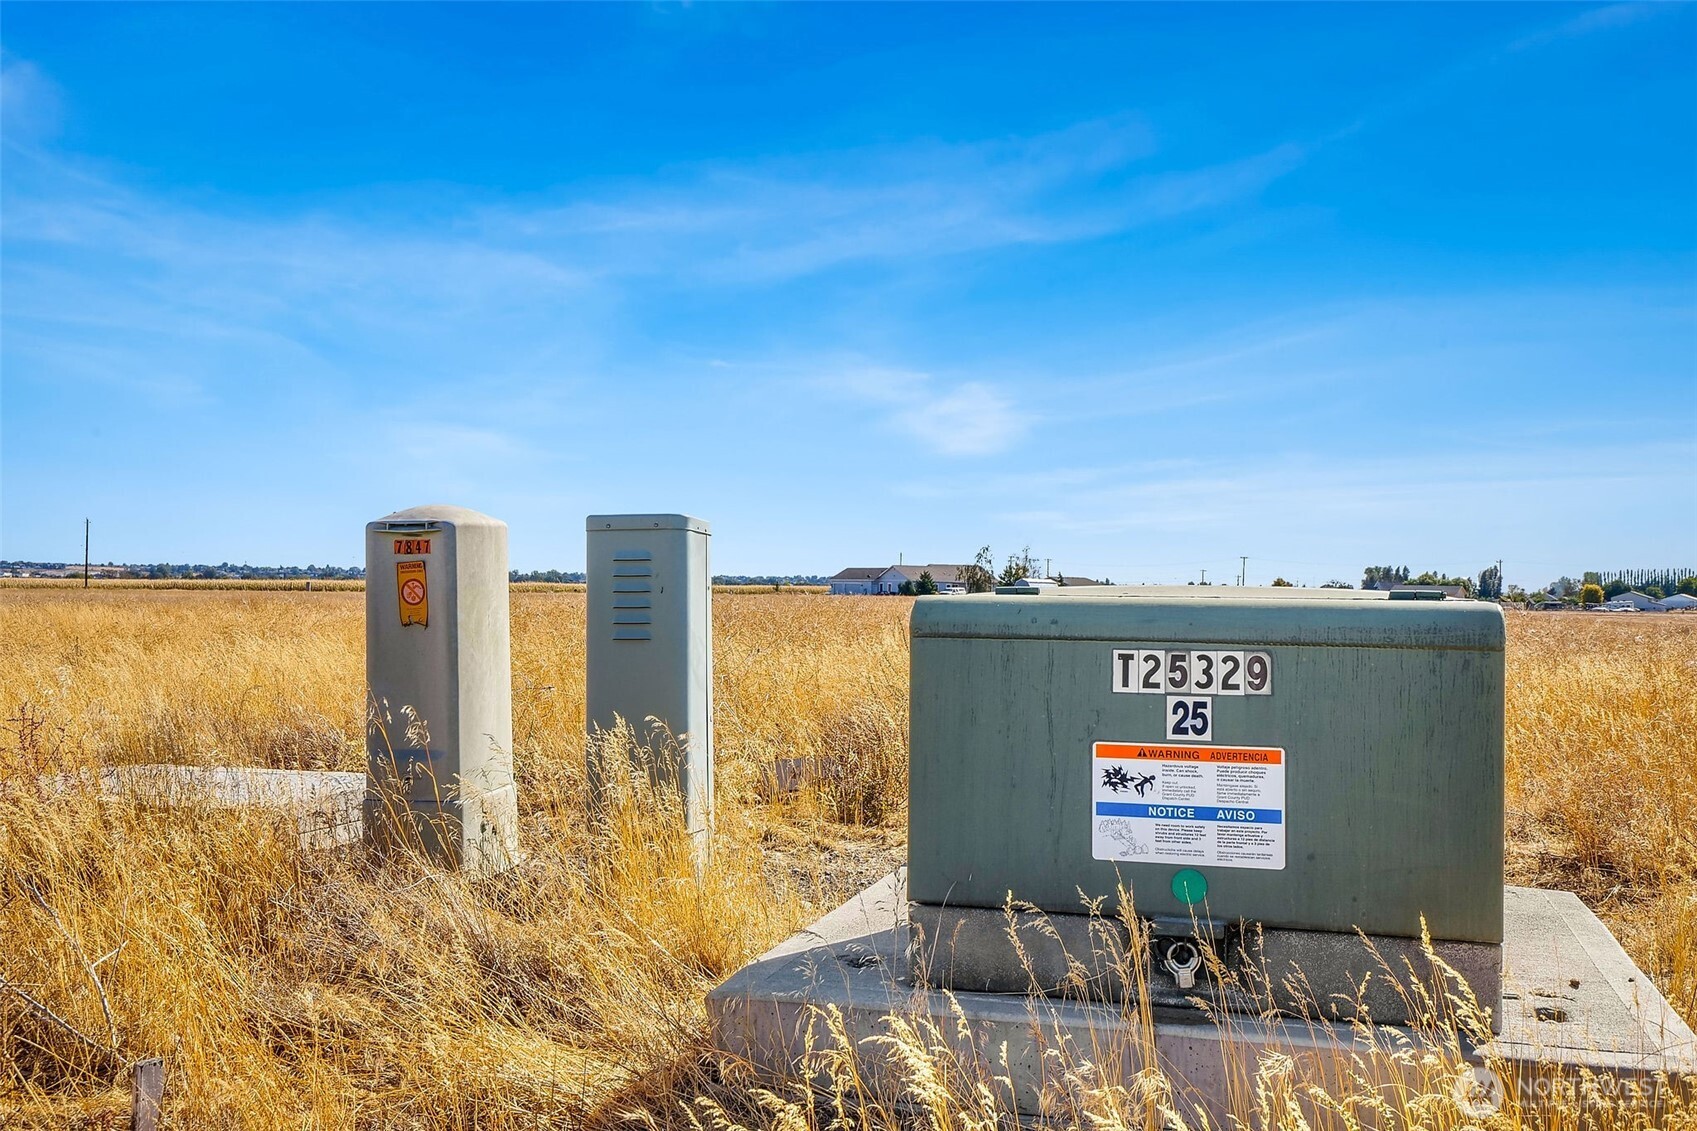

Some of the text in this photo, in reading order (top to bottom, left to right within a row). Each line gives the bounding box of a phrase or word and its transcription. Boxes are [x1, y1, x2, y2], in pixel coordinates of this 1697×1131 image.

[396, 540, 430, 554] 7847
[1117, 653, 1268, 691] T25329
[1171, 700, 1209, 736] 25
[1149, 749, 1269, 762] WARNING ADVERTENCIA
[1148, 806, 1255, 821] NOTICE AVISO
